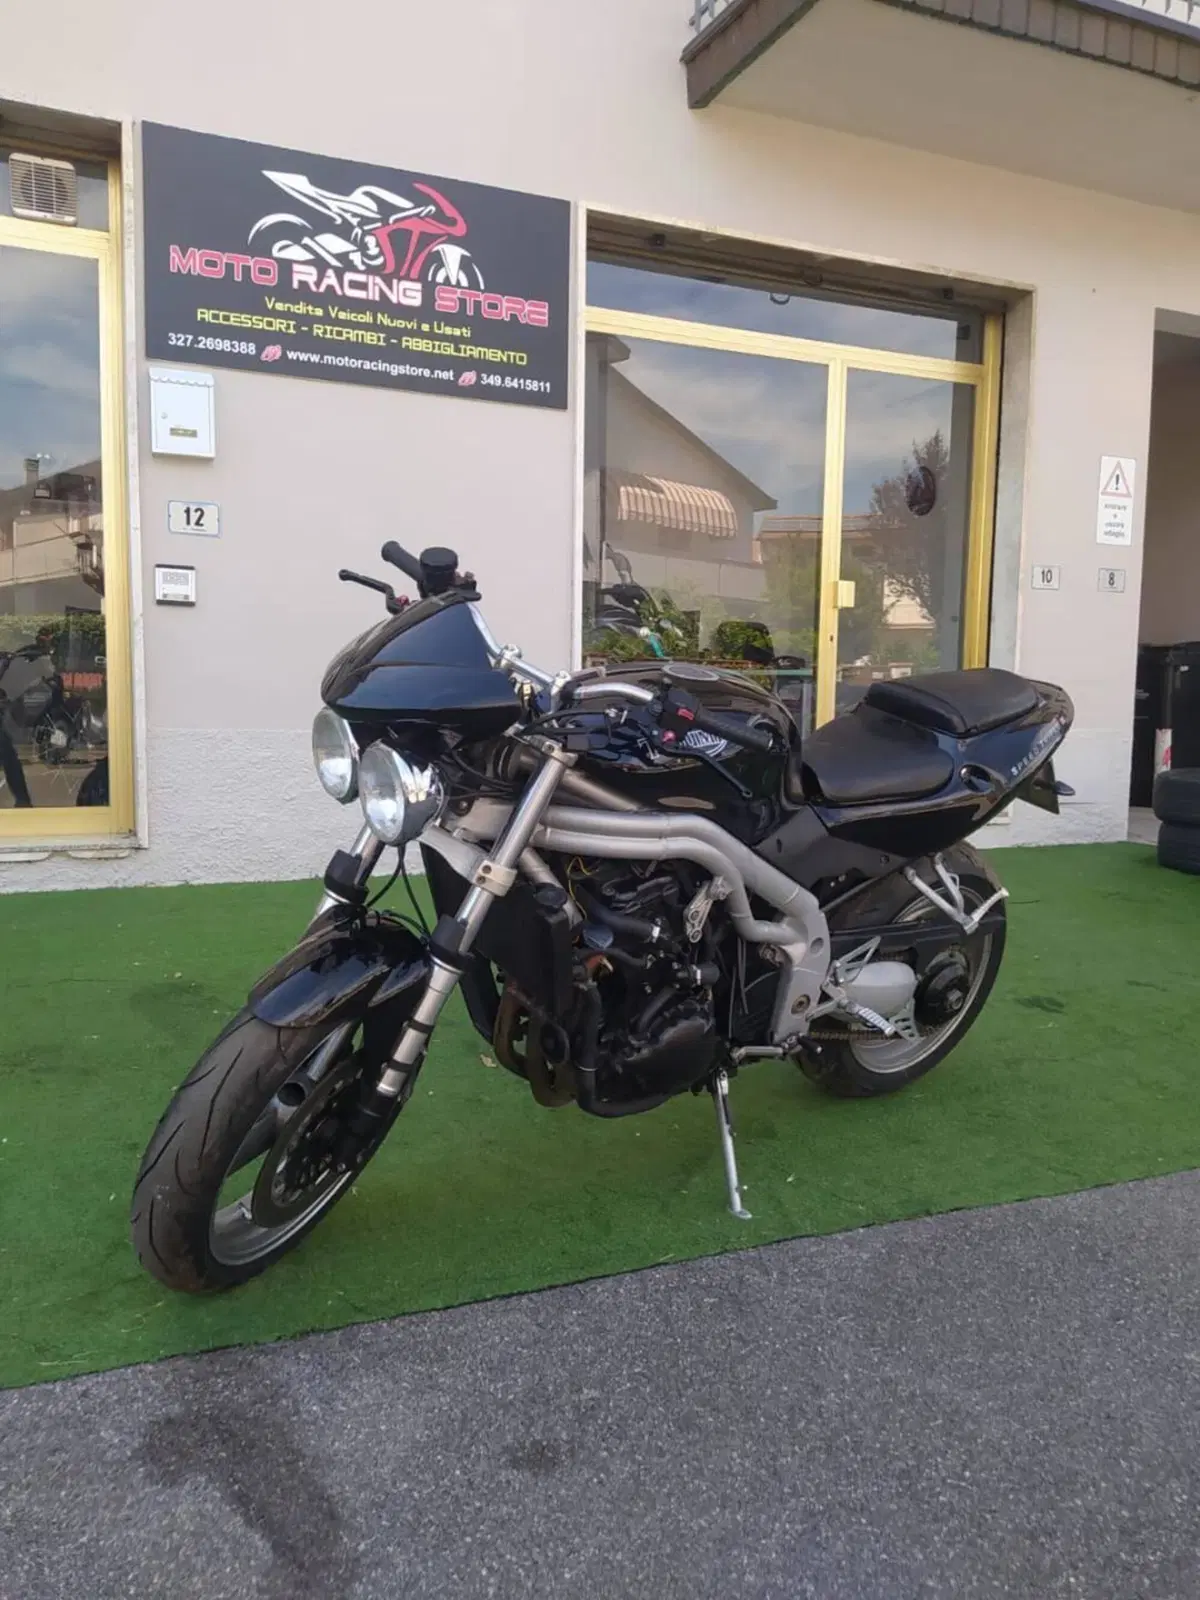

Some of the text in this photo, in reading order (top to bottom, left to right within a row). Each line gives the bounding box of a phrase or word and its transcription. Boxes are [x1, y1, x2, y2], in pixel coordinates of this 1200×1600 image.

[169, 245, 549, 327] MOTO RACING STORE
[196, 308, 297, 335] ACCESSORI
[312, 323, 387, 346] RICAMBI
[401, 336, 528, 366] ABBIGLIAMENTO
[264, 296, 472, 338] Vendita Veicoli Nuovi e Usati
[168, 332, 551, 394] 327.2698388 www.motoracingstore.net 349.6415811
[184, 507, 204, 527] 12
[1041, 568, 1053, 584] 10
[1107, 571, 1116, 587] 8
